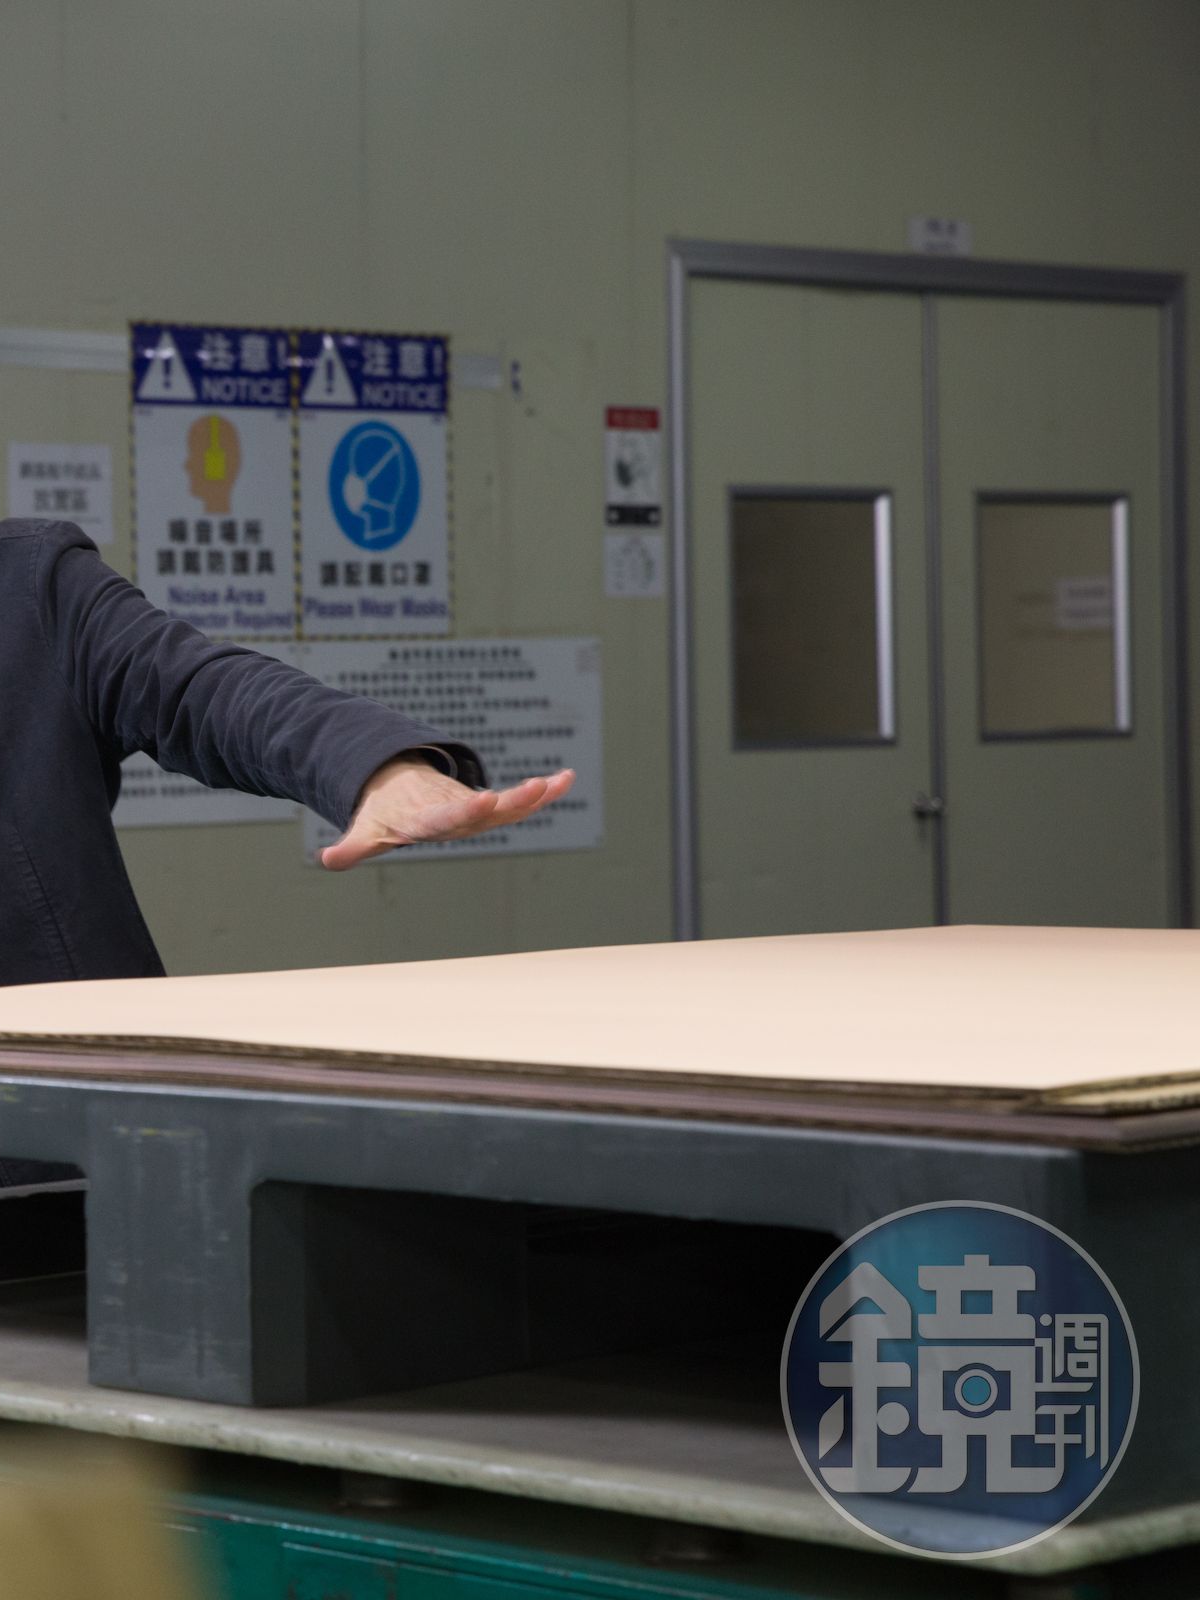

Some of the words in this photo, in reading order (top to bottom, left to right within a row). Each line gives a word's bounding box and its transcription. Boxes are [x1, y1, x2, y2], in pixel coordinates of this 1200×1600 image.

[202, 376, 286, 403] NOTICE
[362, 383, 443, 409] NOTICE
[168, 586, 220, 606] Noise
[223, 586, 266, 605] Area
[303, 599, 354, 618] Please
[358, 599, 396, 617] Wear
[233, 611, 293, 632] Required
